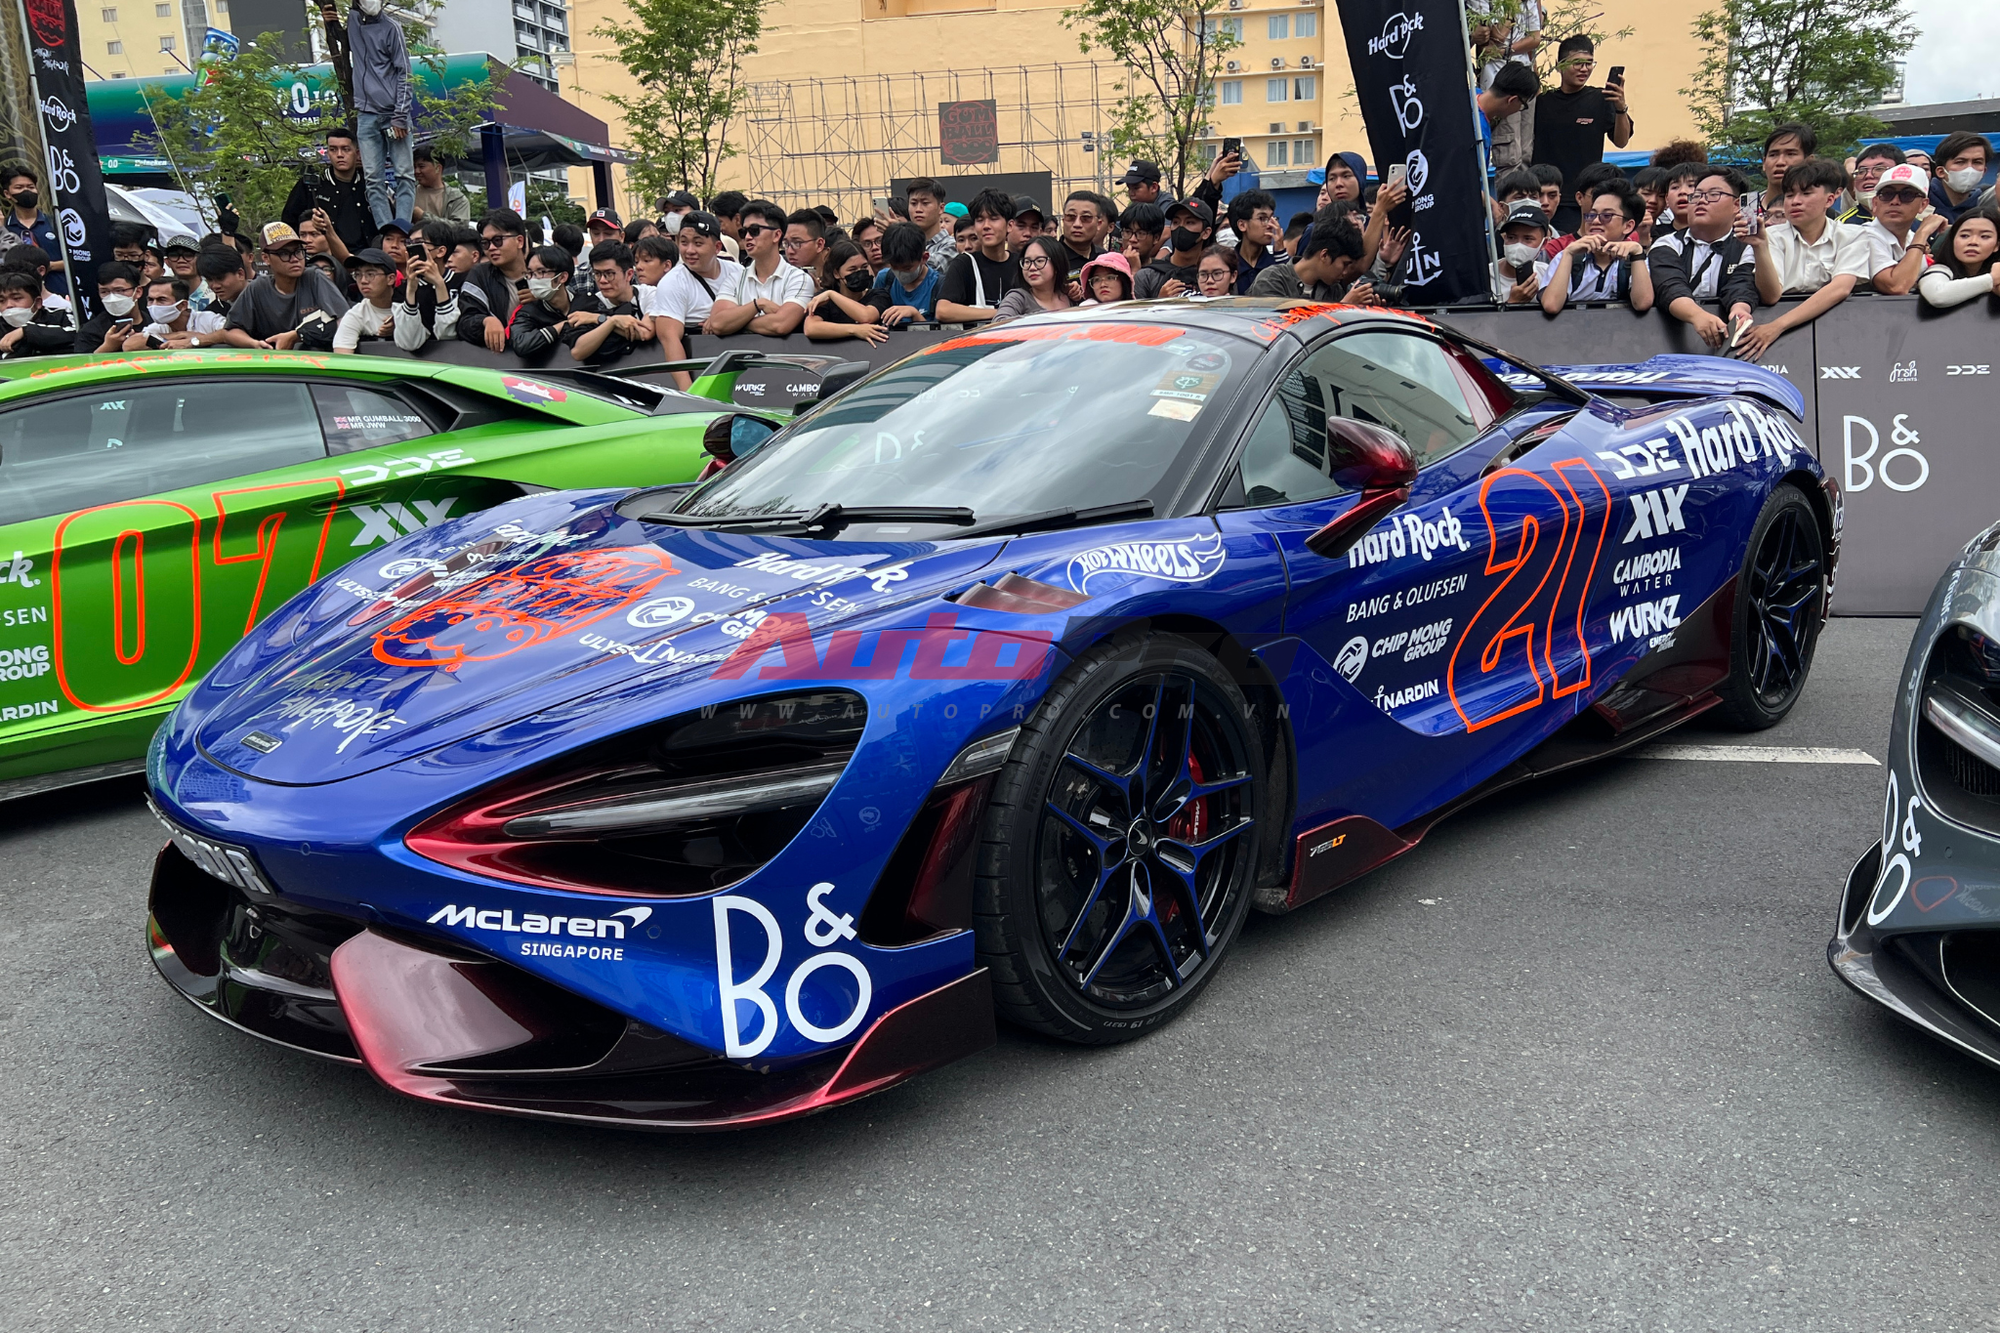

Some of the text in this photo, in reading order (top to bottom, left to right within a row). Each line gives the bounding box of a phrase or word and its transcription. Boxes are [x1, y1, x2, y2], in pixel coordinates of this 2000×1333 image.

[1367, 26, 1399, 55] Hard
[347, 415, 422, 424] MR GUMBALL 3000
[1665, 402, 1758, 479] Hard
[1843, 413, 1930, 493] B&O
[1403, 507, 1467, 561] Rock
[1622, 484, 1690, 544] XIX
[1613, 547, 1682, 585] CAMBODIA
[1620, 574, 1672, 597] WATER
[52, 477, 345, 713] 07
[687, 577, 750, 599] BANG
[1347, 574, 1468, 623] BANG & OLUFSEN
[1447, 457, 1612, 733] 21
[1372, 618, 1453, 659] CHIP MONG
[1610, 595, 1682, 644] WURKZ
[1404, 636, 1447, 663] GROUP
[1384, 679, 1439, 711] NARDIN
[426, 904, 626, 940] McLaren
[520, 942, 624, 962] SINGAPORE
[712, 882, 872, 1058] B&O
